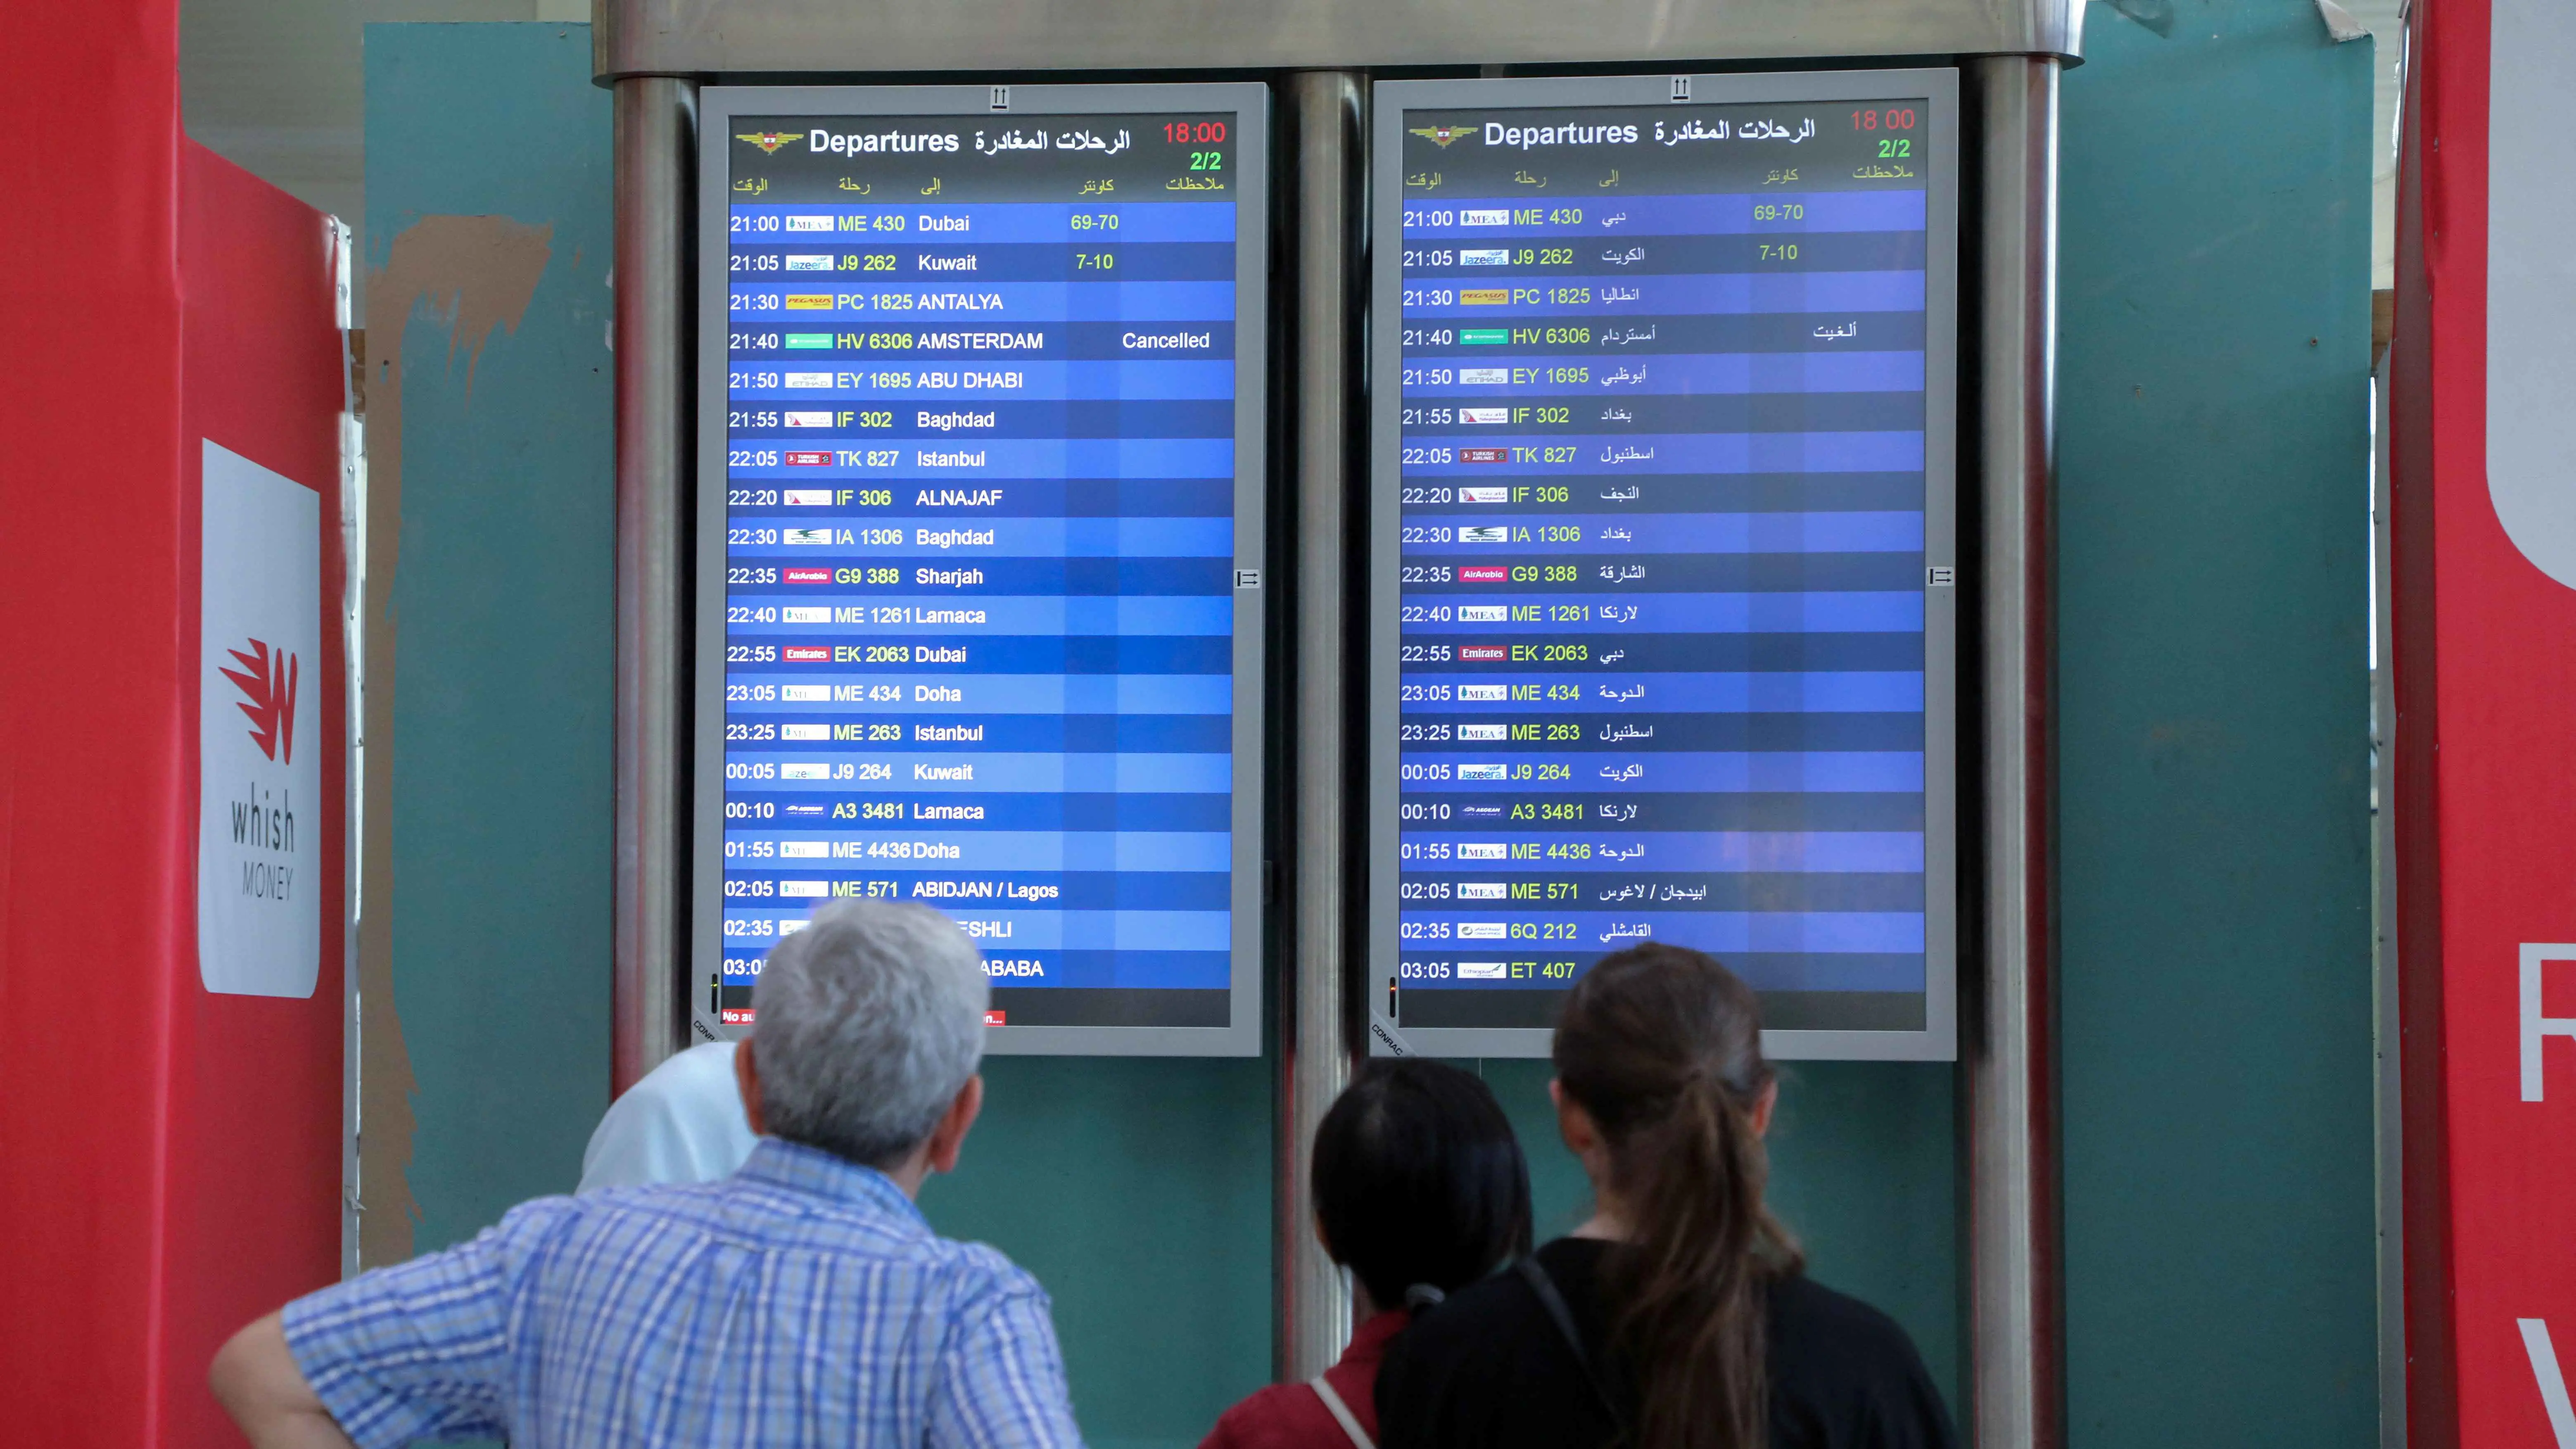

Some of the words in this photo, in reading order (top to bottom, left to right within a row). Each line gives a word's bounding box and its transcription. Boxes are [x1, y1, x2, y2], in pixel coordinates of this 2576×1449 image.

[1164, 123, 1225, 143] 18:00
[1486, 122, 1638, 150] Departures
[1655, 120, 1729, 145] المغادرة
[1739, 118, 1814, 143] الرحلات
[811, 130, 959, 157] Departures
[976, 130, 1047, 155] المغادرة
[1057, 129, 1130, 154] الرحلات
[1878, 140, 1909, 157] 2/2
[1190, 152, 1221, 170] 2/2
[1515, 171, 1546, 188] رحلة
[1599, 170, 1618, 187] إلى
[1763, 169, 1798, 184] كاونتر
[1853, 166, 1913, 178] ملاحظات
[734, 178, 767, 195] الوقت
[839, 178, 870, 195] رحلة
[921, 178, 940, 195] إلى
[1079, 179, 1113, 194] كاونتر
[1166, 177, 1224, 190] ملاحظات
[1406, 173, 1441, 190] الوقت
[1602, 212, 1626, 228] دبي
[1755, 205, 1803, 220] 69-70
[731, 216, 779, 231] 21:00
[839, 216, 867, 231] ME
[873, 216, 905, 231] 430
[919, 216, 969, 231] Dubai
[1071, 215, 1118, 229] 69-70
[919, 255, 977, 270] Kuwait
[1077, 254, 1113, 269] 7-10
[1403, 250, 1452, 266] 21:05
[1513, 249, 1534, 264] J9
[1540, 249, 1572, 264] 262
[1760, 245, 1797, 260] 7-10
[1602, 247, 1644, 265] الكويت
[730, 295, 778, 309] 21:30
[838, 295, 864, 309] PC
[871, 294, 912, 309] 1825
[918, 294, 1003, 309] ANTALYA
[1602, 287, 1638, 304] انطاليا
[917, 333, 1042, 349] AMSTERDAM
[1123, 333, 1209, 348] Cancelled
[1403, 330, 1452, 345] 21:40
[1514, 328, 1541, 344] HV
[1546, 328, 1590, 343] 6306
[1602, 325, 1655, 346] أمستردام
[730, 373, 778, 388] 21:50
[838, 373, 863, 388] EY
[870, 373, 911, 388] 1695
[917, 373, 957, 388] ABU
[964, 372, 1022, 388] DHABI
[1601, 364, 1645, 386] أبوظبي
[918, 412, 994, 431] Baghdad
[1403, 409, 1451, 424] 21:55
[1514, 408, 1530, 423] IF
[1537, 408, 1569, 423] 302
[1601, 408, 1631, 423] بغداد
[729, 451, 777, 466] 22:05
[836, 451, 862, 466] TK
[867, 451, 899, 466] 827
[918, 451, 985, 466] Istanbul
[1601, 446, 1653, 463] اسطنبول
[916, 490, 1002, 505] ALNAJAF
[1402, 488, 1451, 503] 22:20
[1513, 487, 1529, 502] IF
[1537, 487, 1568, 502] 306
[1601, 486, 1639, 502] النجف
[729, 529, 776, 544] 22:30
[837, 529, 854, 544] IA
[861, 529, 902, 544] 1306
[917, 529, 993, 549] Baghdad
[1601, 527, 1631, 542] بغداد
[916, 568, 983, 587] Sharjah
[1402, 567, 1451, 582] 22:35
[1512, 566, 1538, 581] G9
[1545, 566, 1576, 581] 388
[1600, 565, 1645, 583] الشارقة
[728, 607, 776, 622] 22:40
[836, 608, 864, 623] ME
[871, 608, 910, 623] 1261
[916, 608, 985, 623] Larnaca
[1600, 606, 1637, 622] لارنكا
[787, 650, 827, 659] Emirates
[916, 646, 966, 662] Dubai
[1402, 646, 1451, 661] 22:55
[1512, 646, 1538, 660] EK
[1544, 645, 1587, 660] 2063
[1463, 649, 1503, 658] Emirates
[1600, 649, 1624, 664] دبي
[727, 685, 775, 701] 23:05
[835, 686, 863, 701] ME
[869, 686, 901, 701] 434
[915, 686, 961, 701] Doha
[1600, 684, 1644, 702] الدوحة
[915, 725, 983, 741] Istanbul
[1401, 725, 1450, 740] 23:25
[1512, 725, 1541, 740] ME
[1547, 725, 1579, 740] 263
[1600, 724, 1652, 741] اسطنبول
[727, 763, 774, 779] 00:05
[833, 764, 854, 779] J9
[859, 764, 892, 779] 264
[915, 764, 973, 779] Kuwait
[1600, 764, 1642, 782] الكويت
[232, 782, 294, 853] whish
[914, 803, 984, 819] Larnaca
[1402, 804, 1450, 819] 00:10
[1511, 804, 1535, 819] A3
[1542, 804, 1582, 819] 3481
[1600, 805, 1637, 821] لارنكا
[725, 841, 774, 857] 01:55
[833, 842, 862, 858] ME
[867, 842, 911, 858] 4436
[914, 842, 959, 858] Doha
[1599, 843, 1644, 861] الدوحة
[242, 861, 293, 901] MONEY
[725, 881, 773, 896] 02:05
[833, 881, 861, 896] ME
[868, 882, 896, 897] 571
[912, 882, 992, 897] ABIDJAN
[1009, 882, 1058, 901] Lagos
[1401, 883, 1450, 898] 02:05
[1512, 884, 1541, 899] ME
[1548, 884, 1576, 899] 571
[1600, 884, 1644, 901] لاغوس
[1661, 885, 1706, 900] ابيدجان
[724, 920, 773, 936] 02:35
[1600, 923, 1650, 943] القامشلي
[724, 959, 767, 975] 03:0
[1401, 963, 1450, 978] 03:05
[1512, 963, 1536, 978] ET
[1543, 963, 1575, 978] 407
[723, 1012, 739, 1022] No
[1371, 1024, 1403, 1056] CONRAC
